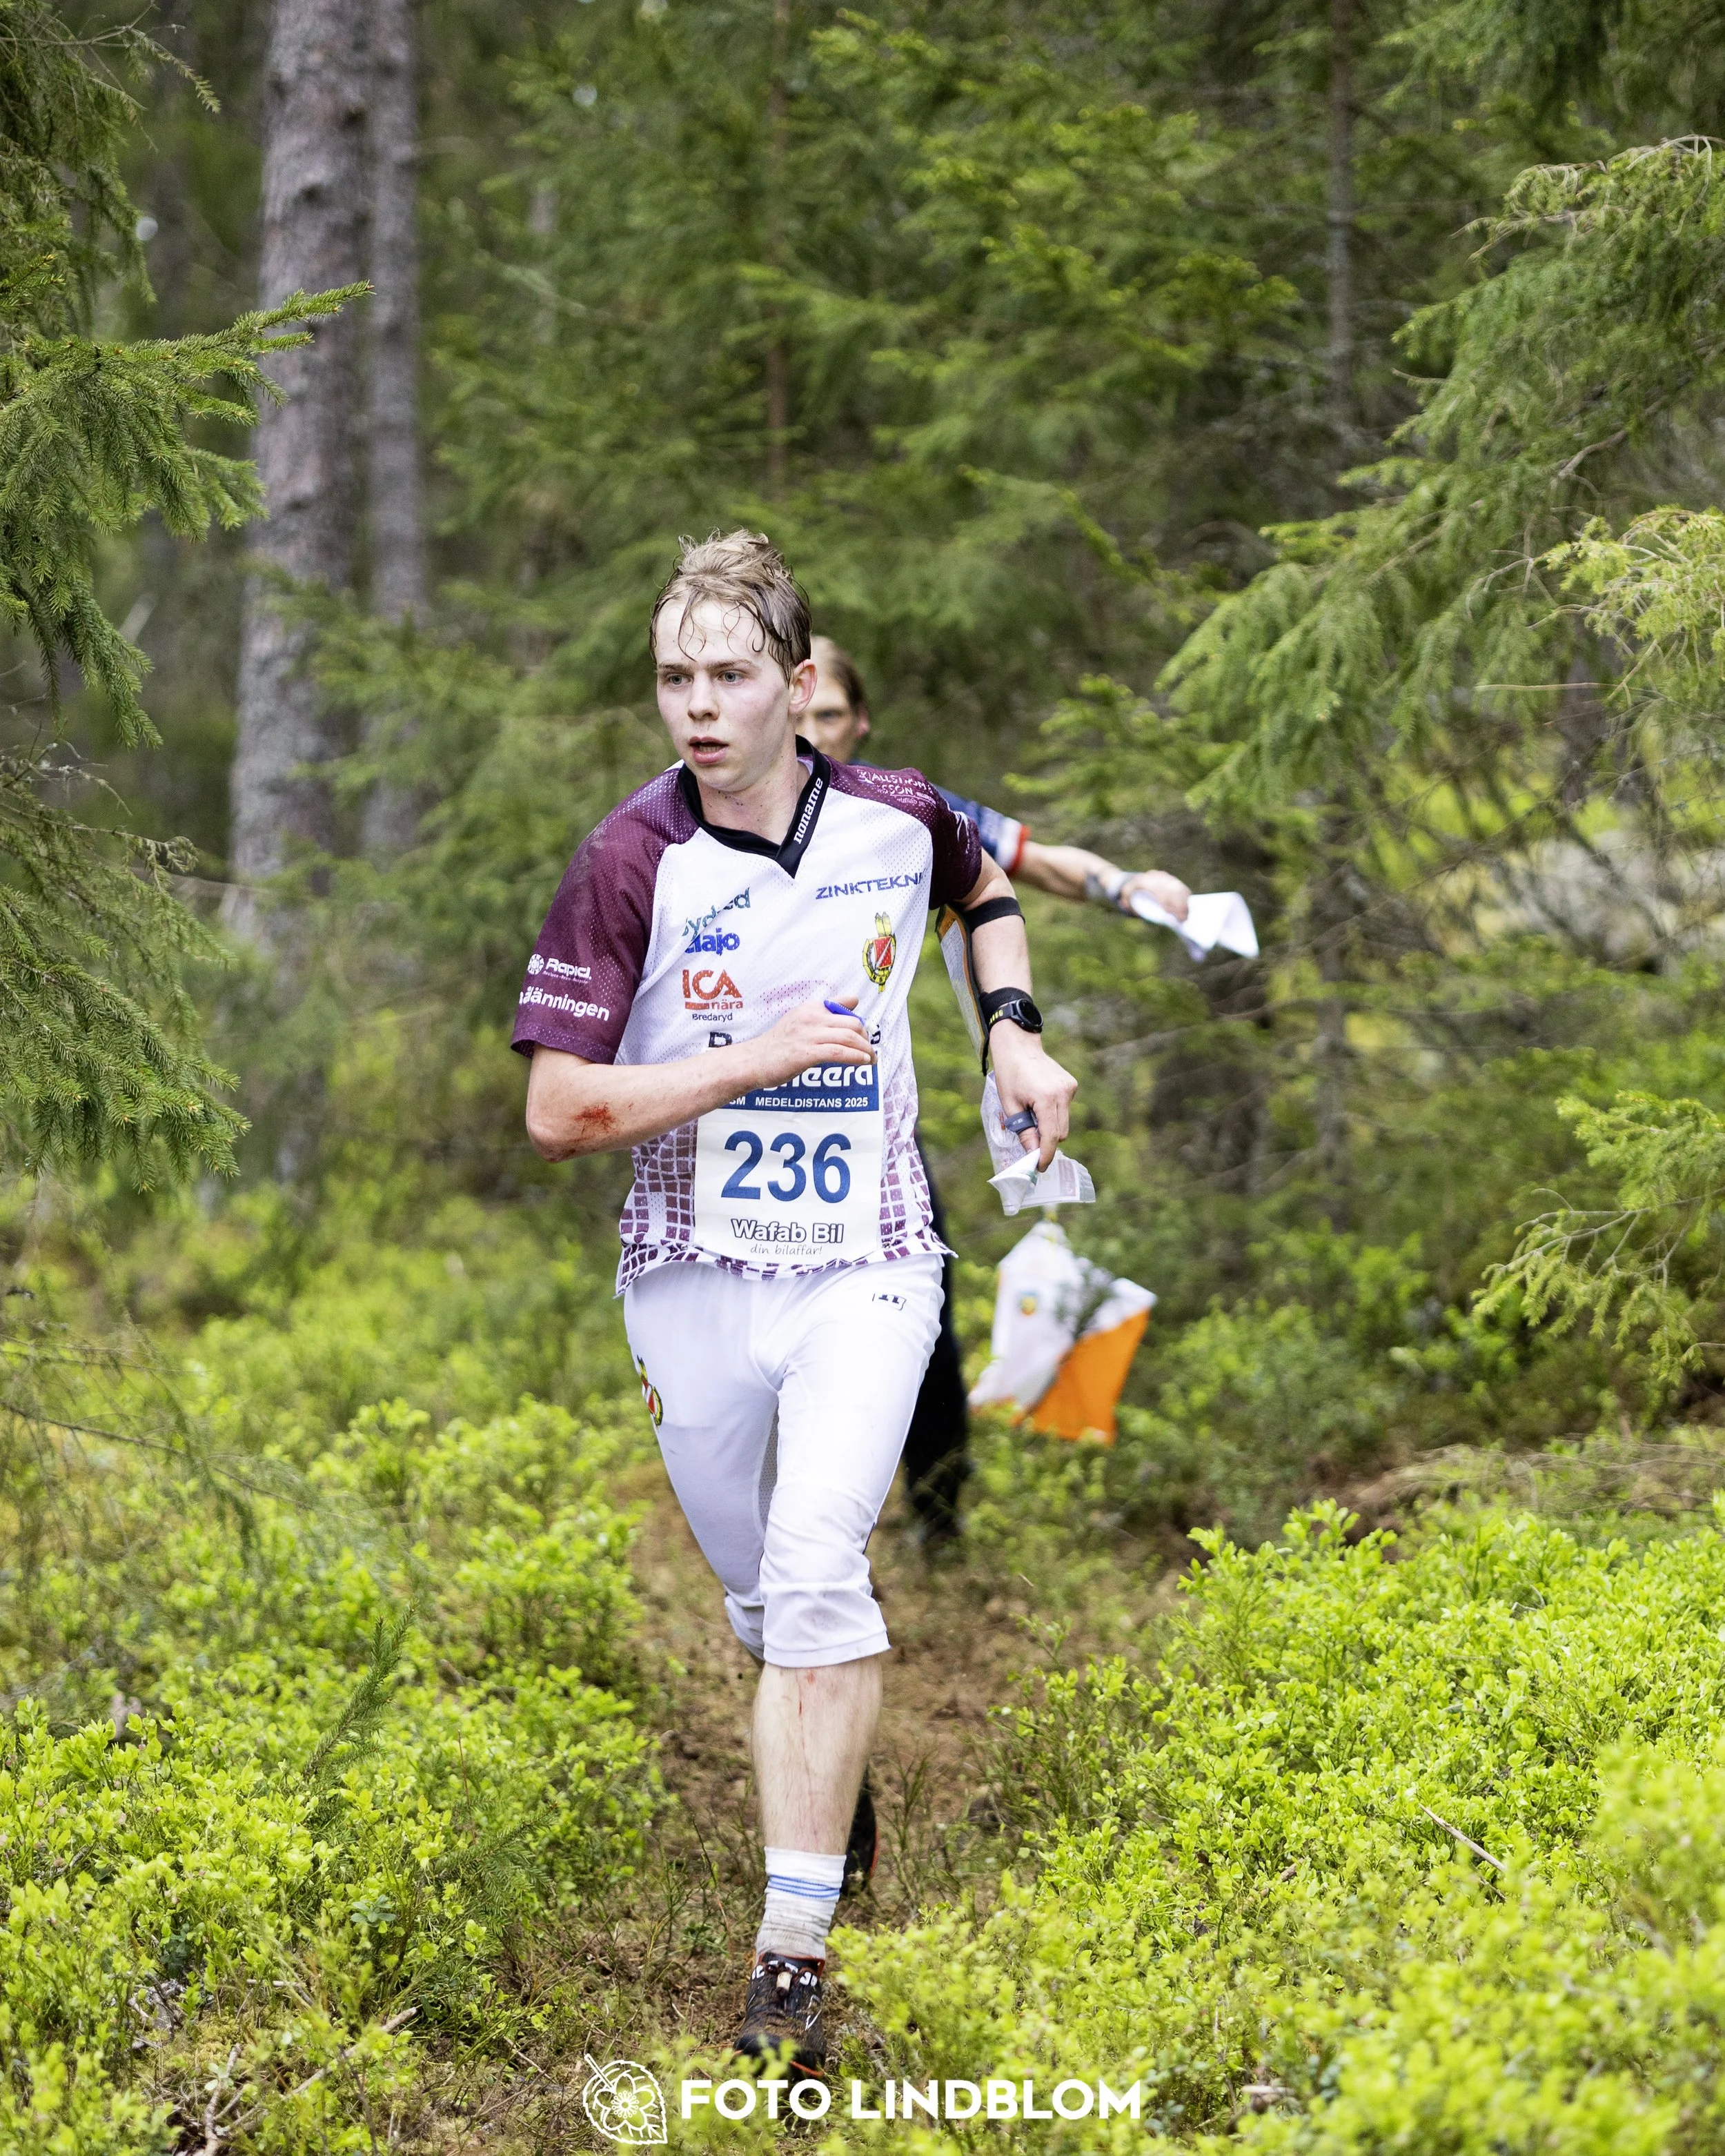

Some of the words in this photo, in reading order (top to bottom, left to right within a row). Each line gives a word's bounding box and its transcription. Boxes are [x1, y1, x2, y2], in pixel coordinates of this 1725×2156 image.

[793, 778, 823, 844] noname
[682, 969, 742, 1000] ICA
[711, 999, 743, 1010] nära
[692, 1013, 733, 1022] Bredaryd
[756, 1097, 842, 1107] MEDELDISTANS
[845, 1097, 868, 1107] 2025
[721, 1130, 851, 1203] 236
[731, 1218, 807, 1243] Wafab
[812, 1223, 844, 1243] Bil
[750, 1244, 769, 1254] din
